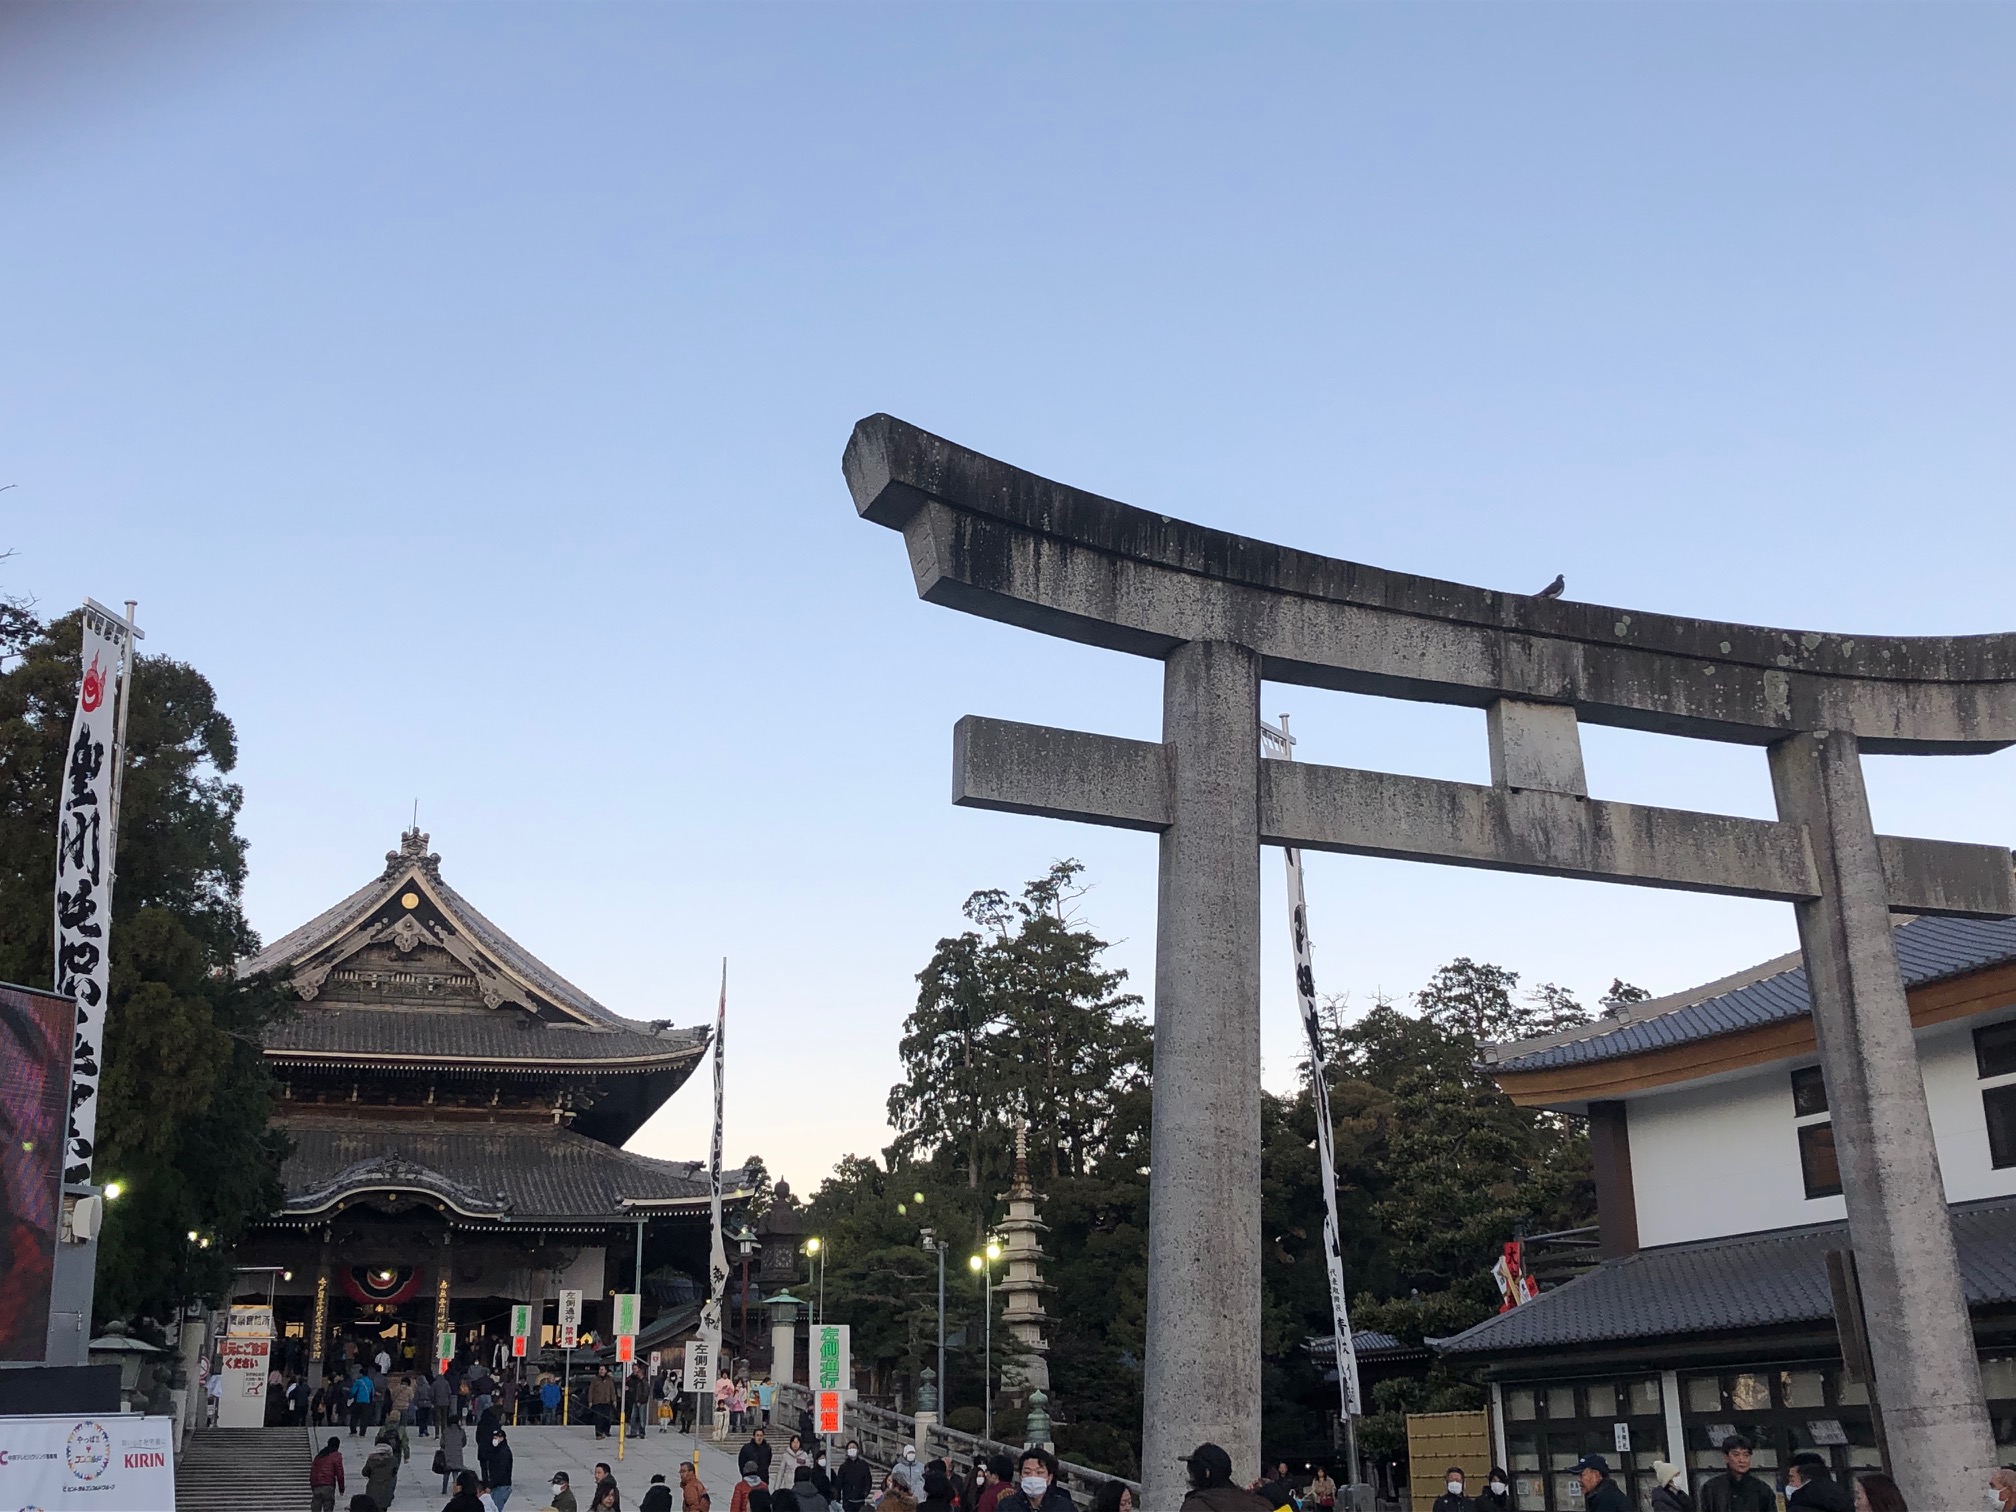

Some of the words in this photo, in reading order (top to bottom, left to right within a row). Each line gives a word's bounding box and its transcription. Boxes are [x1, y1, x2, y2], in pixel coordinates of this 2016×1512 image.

[564, 1291, 577, 1324] 左側通行
[564, 1326, 574, 1346] 禁煙
[225, 1358, 259, 1369] ください
[693, 1343, 709, 1390] 左側通行
[820, 1326, 840, 1389] 左側通行
[820, 1392, 839, 1432] 禁煙
[124, 1453, 165, 1468] KIRIN
